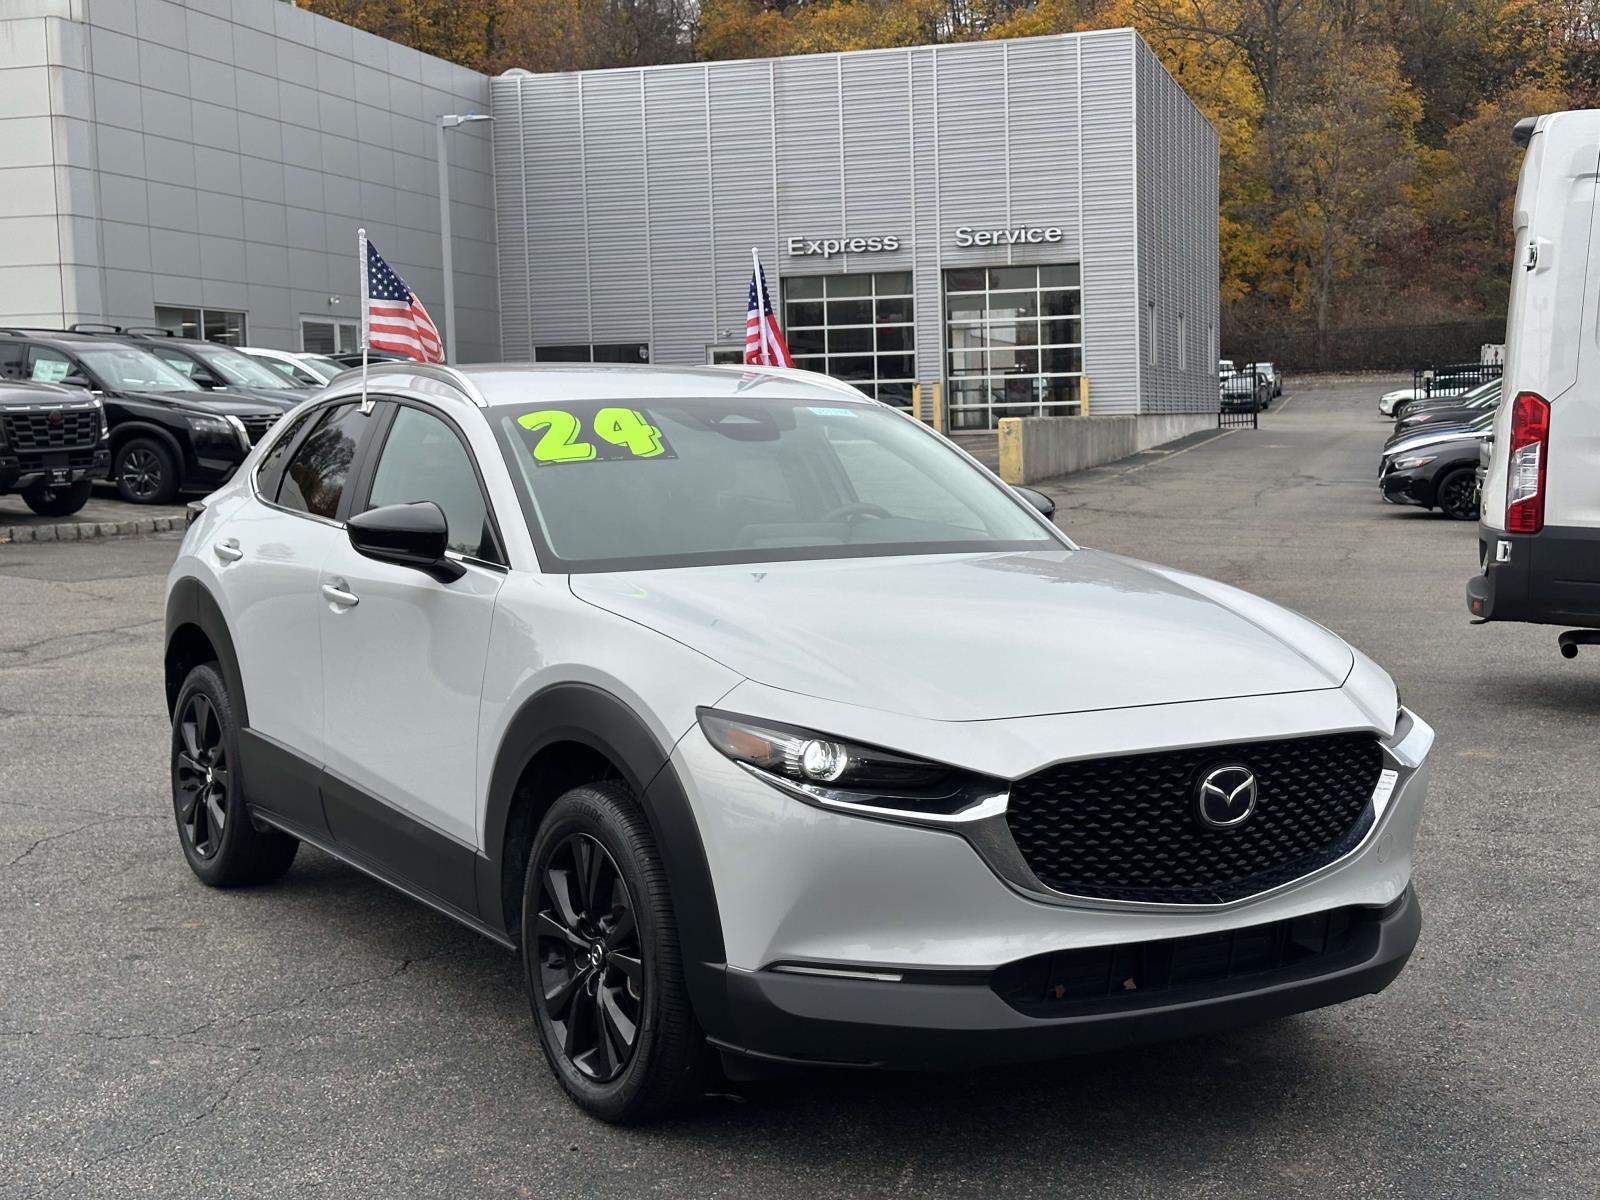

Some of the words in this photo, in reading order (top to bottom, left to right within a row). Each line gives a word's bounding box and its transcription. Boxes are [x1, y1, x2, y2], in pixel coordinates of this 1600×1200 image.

[787, 235, 900, 258] Express
[955, 225, 1063, 247] Service
[517, 407, 665, 463] 24
